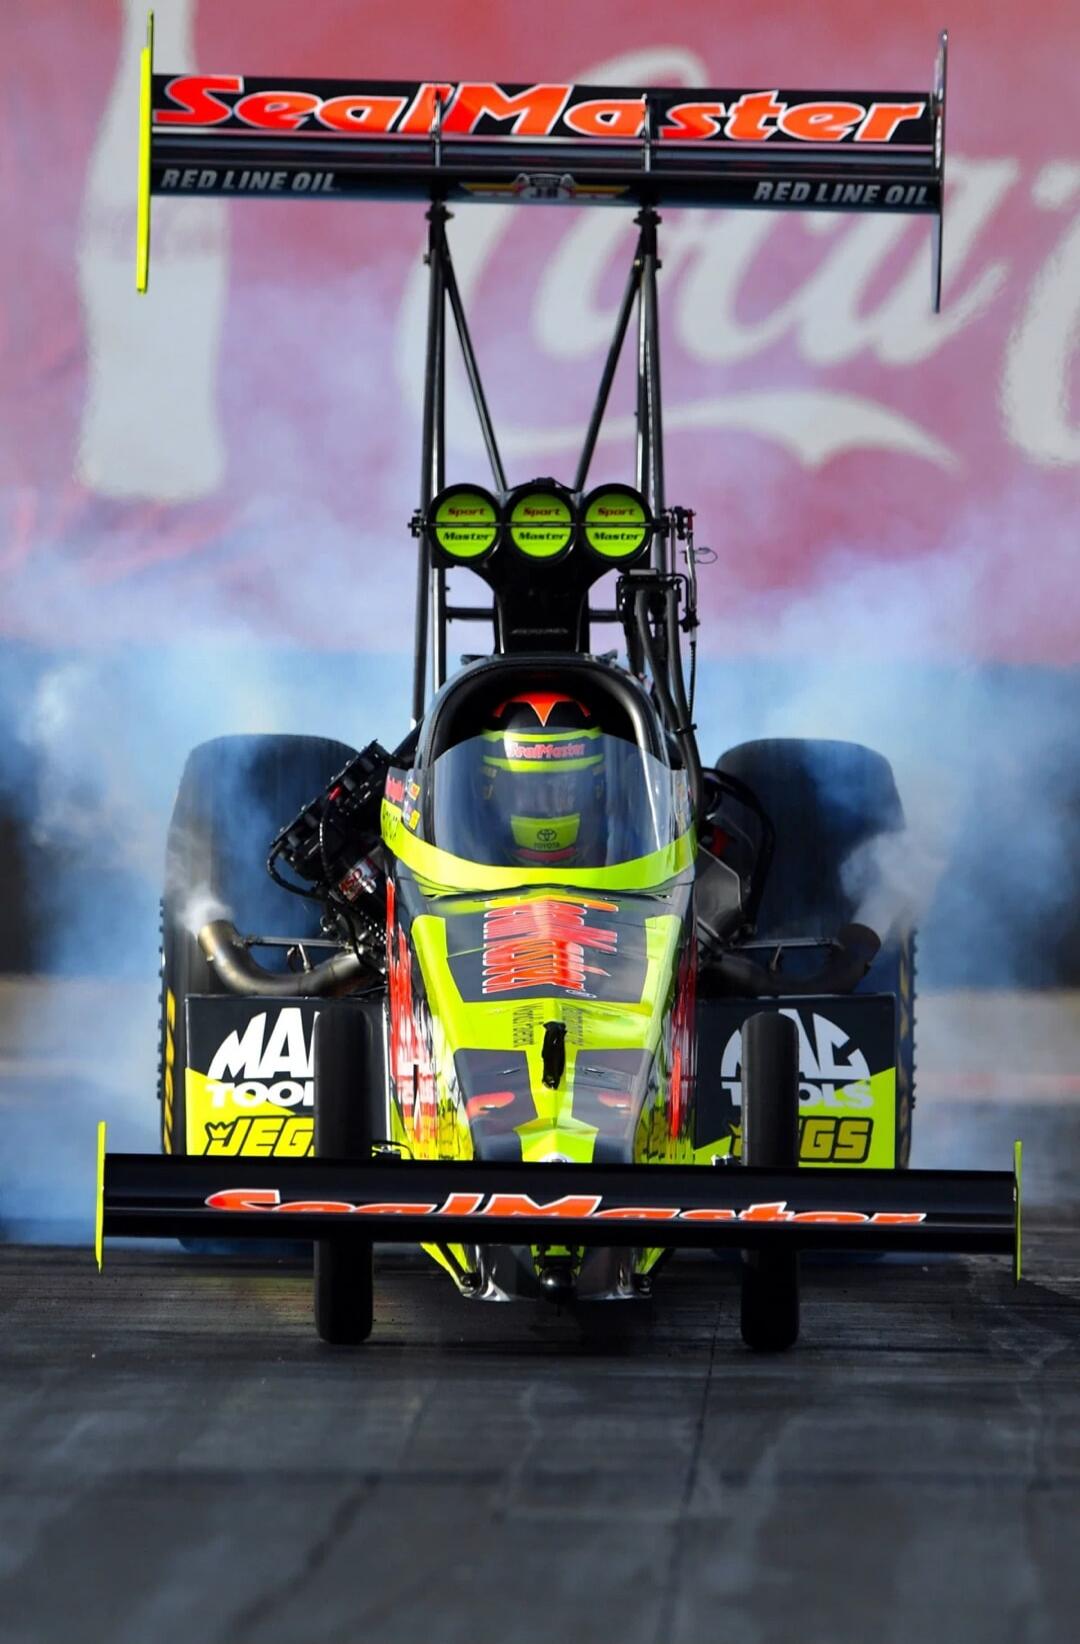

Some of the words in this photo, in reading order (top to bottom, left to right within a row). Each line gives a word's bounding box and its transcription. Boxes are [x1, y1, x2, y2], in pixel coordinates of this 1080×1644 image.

[152, 74, 927, 142] SealMaster
[160, 168, 217, 190] RED
[221, 170, 288, 191] LINE
[291, 172, 336, 192] OIL
[753, 181, 811, 202] RED
[815, 183, 879, 204] LINE
[884, 185, 928, 205] OIL
[448, 506, 486, 518] Sport
[523, 506, 561, 518] Sport
[597, 506, 635, 518] Sport
[443, 531, 491, 541] Master
[518, 531, 566, 541] Master
[593, 531, 641, 541] Master
[207, 1007, 320, 1080] MA
[206, 1080, 315, 1108] TOO
[721, 1081, 874, 1109] TOLS
[203, 1115, 315, 1158] JEG
